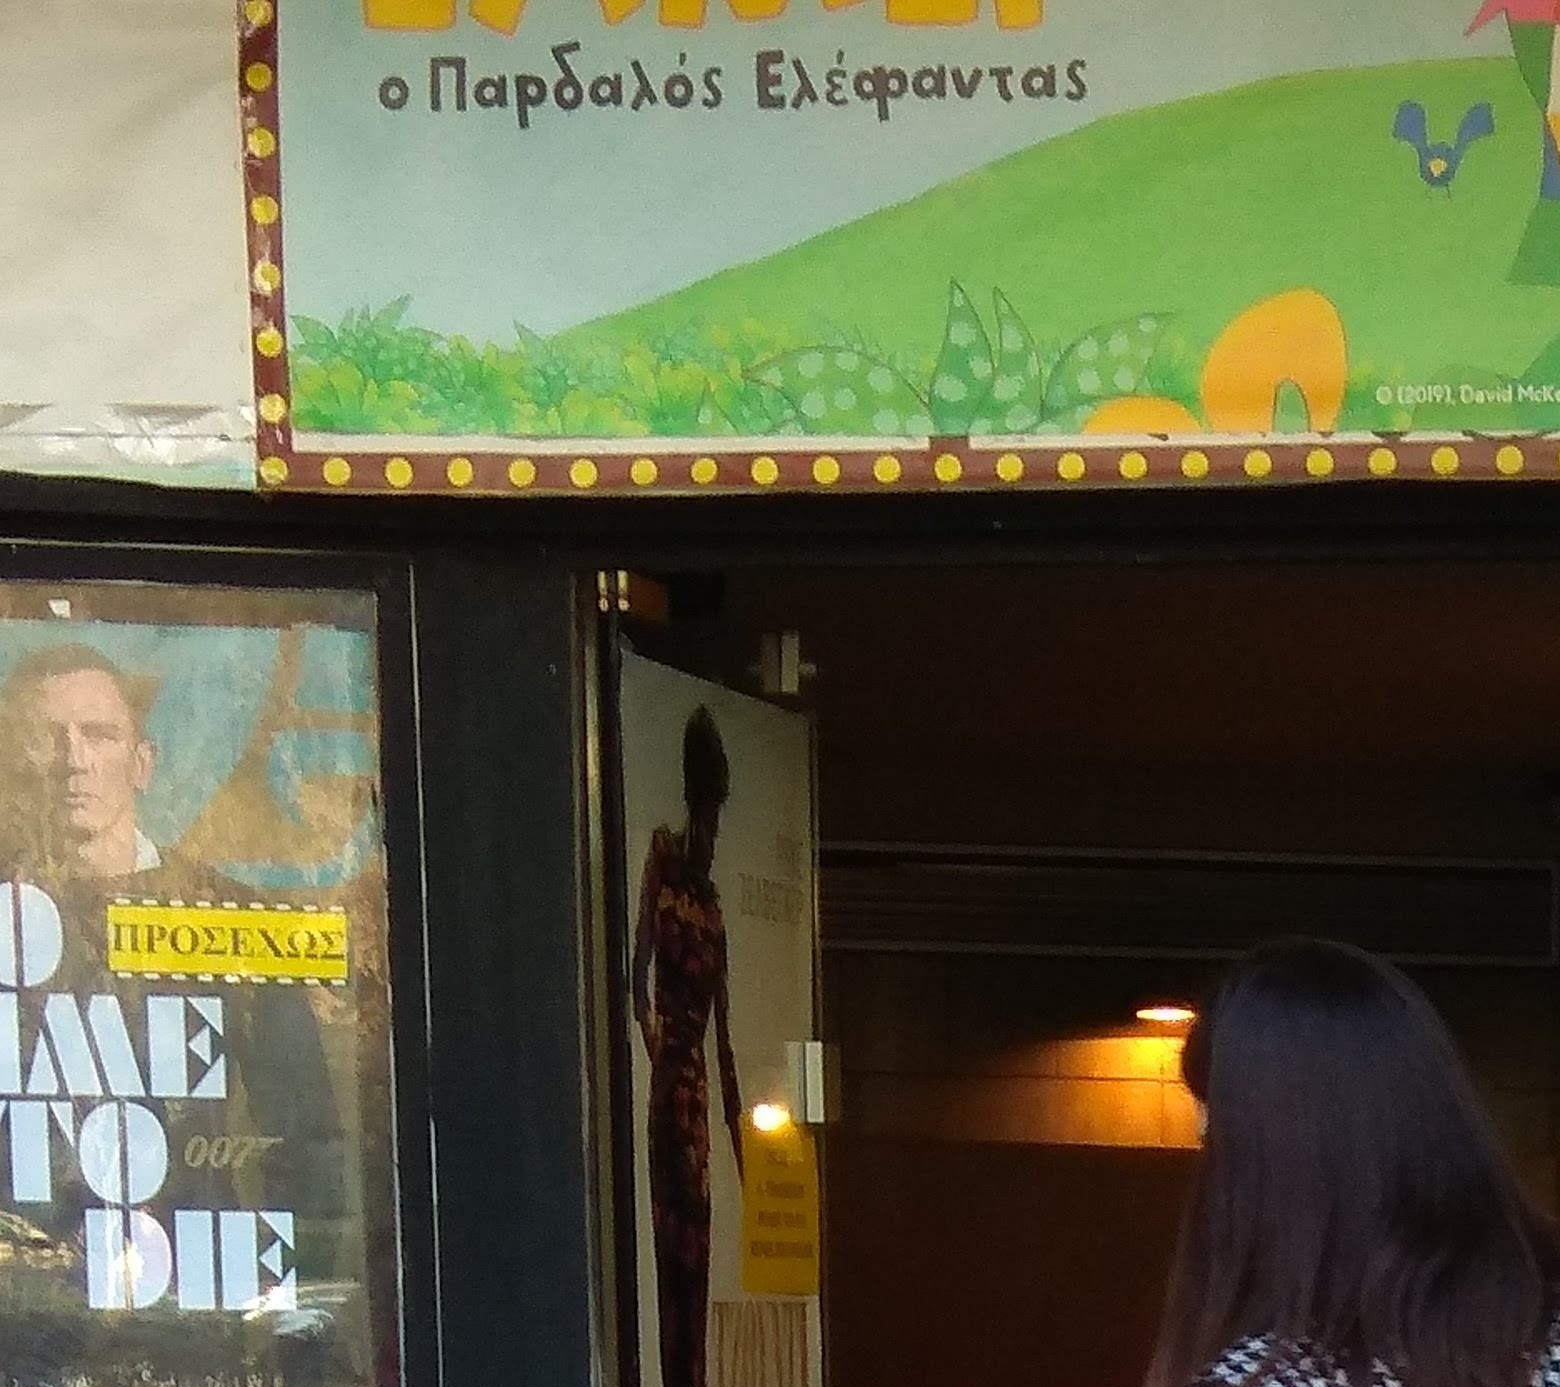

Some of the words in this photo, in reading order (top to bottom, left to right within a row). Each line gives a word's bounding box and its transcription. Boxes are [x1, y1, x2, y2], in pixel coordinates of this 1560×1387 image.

[378, 74, 409, 111] ο
[429, 41, 724, 128] Παρδαλός
[757, 50, 1089, 122] Ελέφαντας
[1460, 384, 1512, 403] David
[0, 880, 63, 988] O
[114, 922, 346, 962] ΠΡΟΣΕΧΩΣ
[0, 990, 227, 1100] IME
[0, 1101, 168, 1204] TO
[184, 1134, 284, 1169] 007
[84, 1207, 298, 1312] DIE
